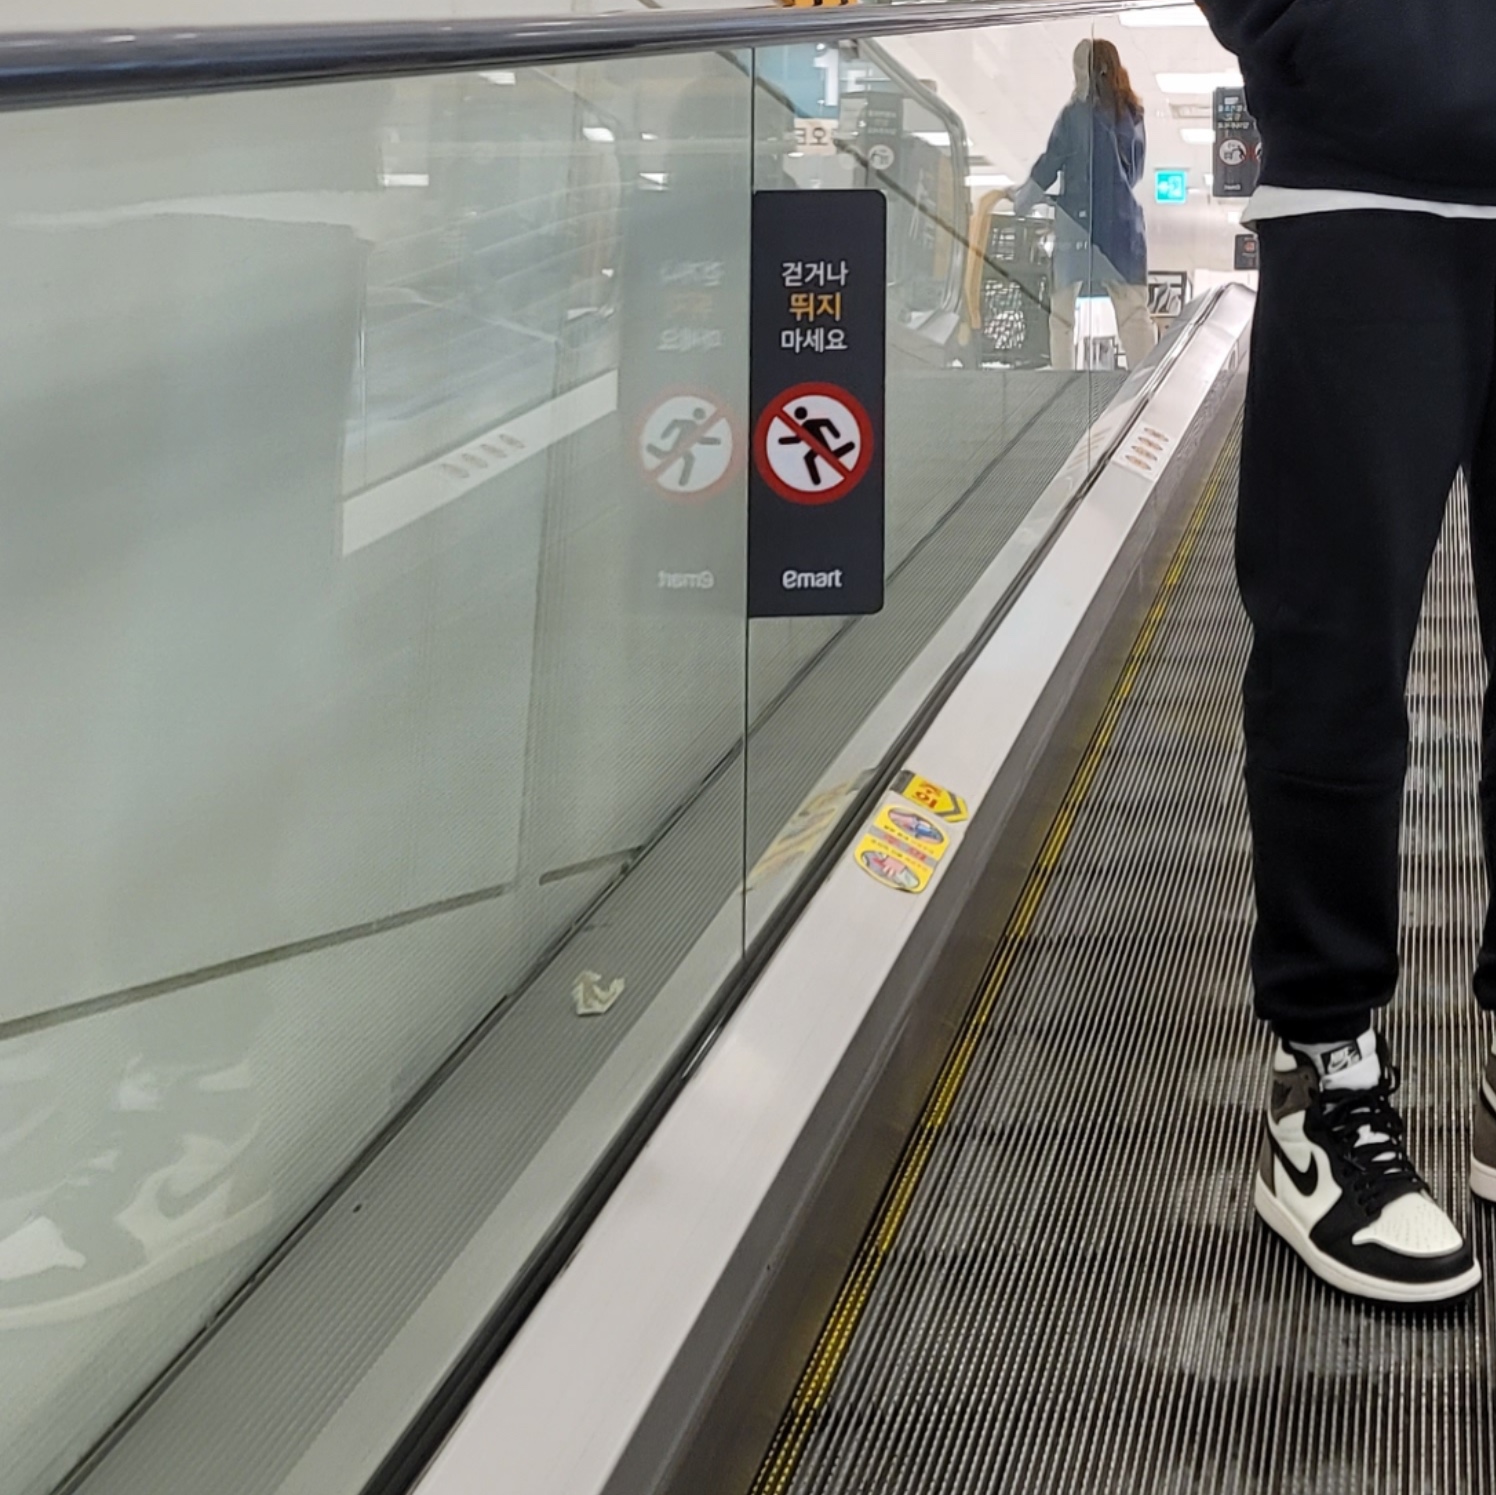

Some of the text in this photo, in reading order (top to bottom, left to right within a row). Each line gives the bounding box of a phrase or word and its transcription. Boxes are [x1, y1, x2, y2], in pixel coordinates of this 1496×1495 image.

[781, 260, 849, 287] 걷거나
[789, 292, 842, 321] 뛰지
[780, 327, 849, 354] 마세요
[782, 568, 843, 590] emart
